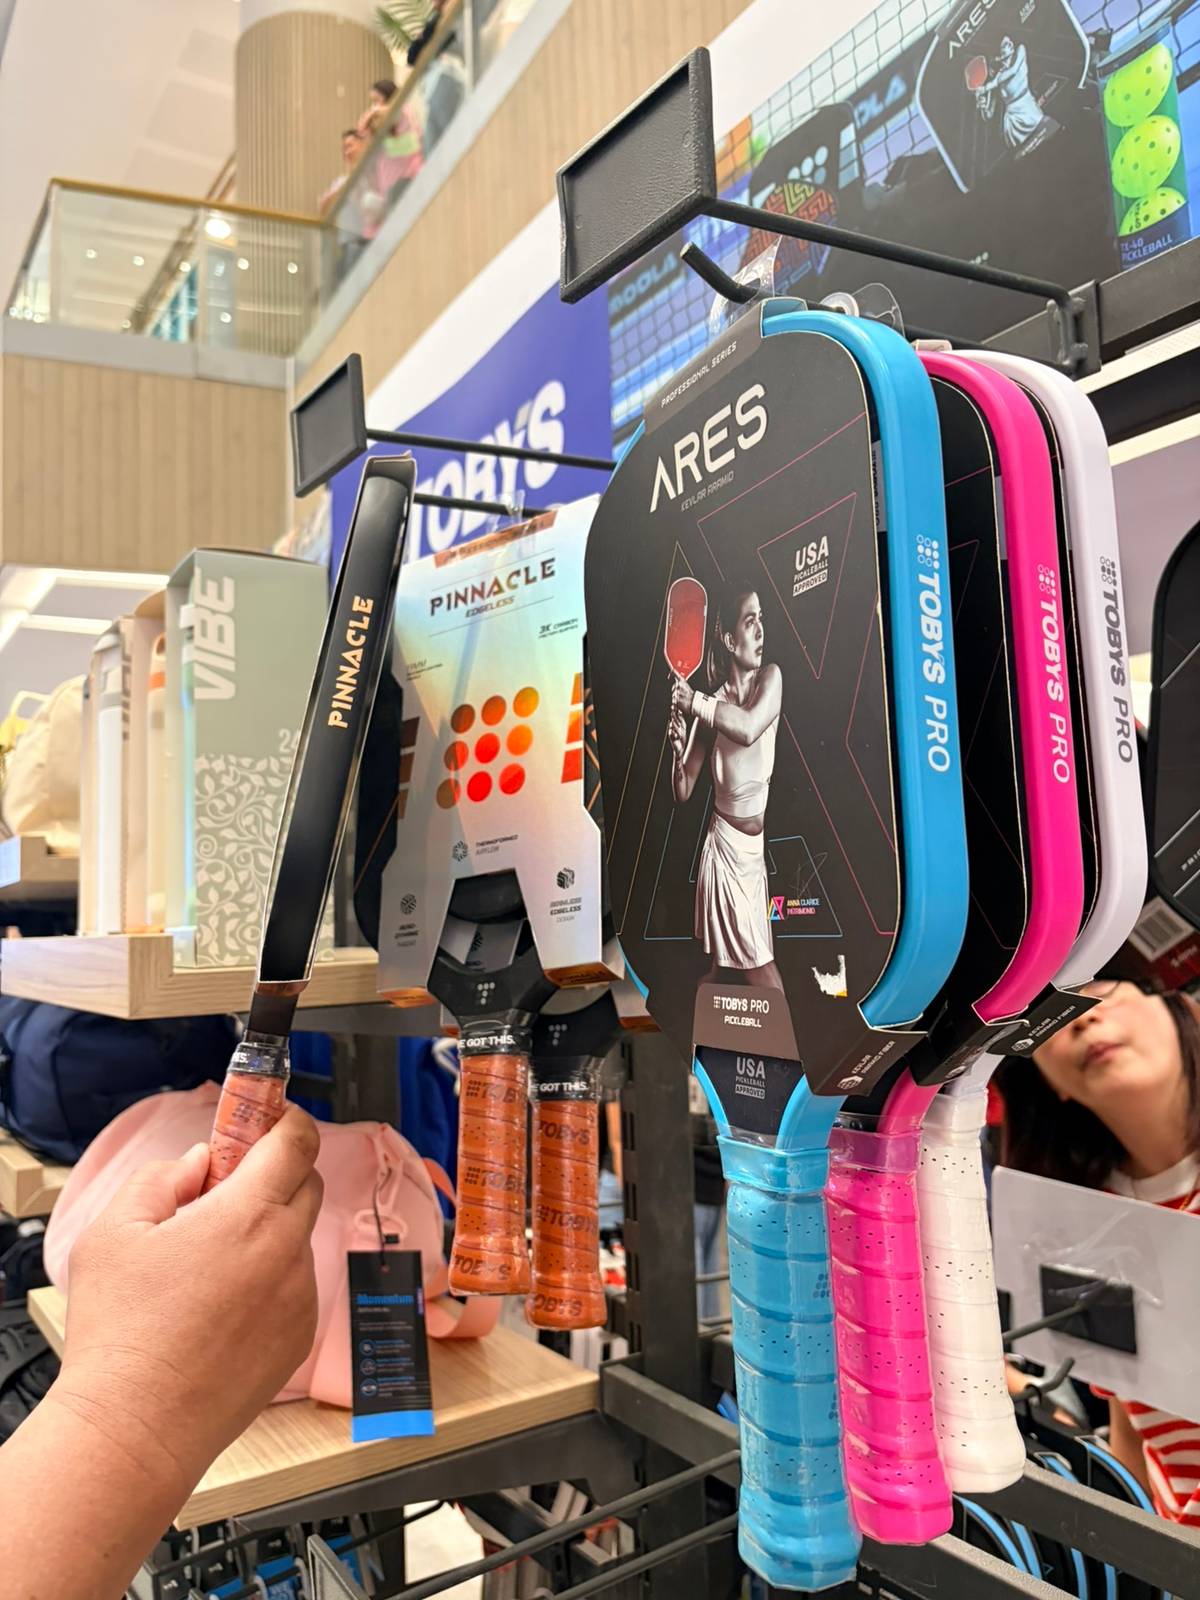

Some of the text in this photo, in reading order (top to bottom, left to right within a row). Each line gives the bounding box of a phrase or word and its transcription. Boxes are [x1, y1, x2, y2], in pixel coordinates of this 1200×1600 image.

[661, 341, 737, 408] PROFESSIONAL SERIES
[650, 384, 768, 513] ARES
[795, 535, 829, 571] USA
[793, 558, 829, 583] PICKLEBALL
[793, 569, 828, 597] APPROVED
[429, 557, 556, 617] PINNACLE
[465, 595, 515, 618] EDGELESS
[194, 566, 236, 700] VIBE
[328, 595, 374, 729] PINNACLE
[924, 694, 950, 773] PRO
[1113, 695, 1133, 764] PRO
[1050, 712, 1070, 784] PRO
[750, 999, 770, 1014] PRO
[724, 1015, 762, 1028] PICKLEBALL
[466, 1037, 487, 1047] GOT
[488, 1034, 516, 1045] THIS.
[735, 1075, 766, 1088] PICKLEBALL
[736, 1056, 766, 1080] USA
[540, 1083, 561, 1091] GOT
[735, 1084, 766, 1099] APPROVED
